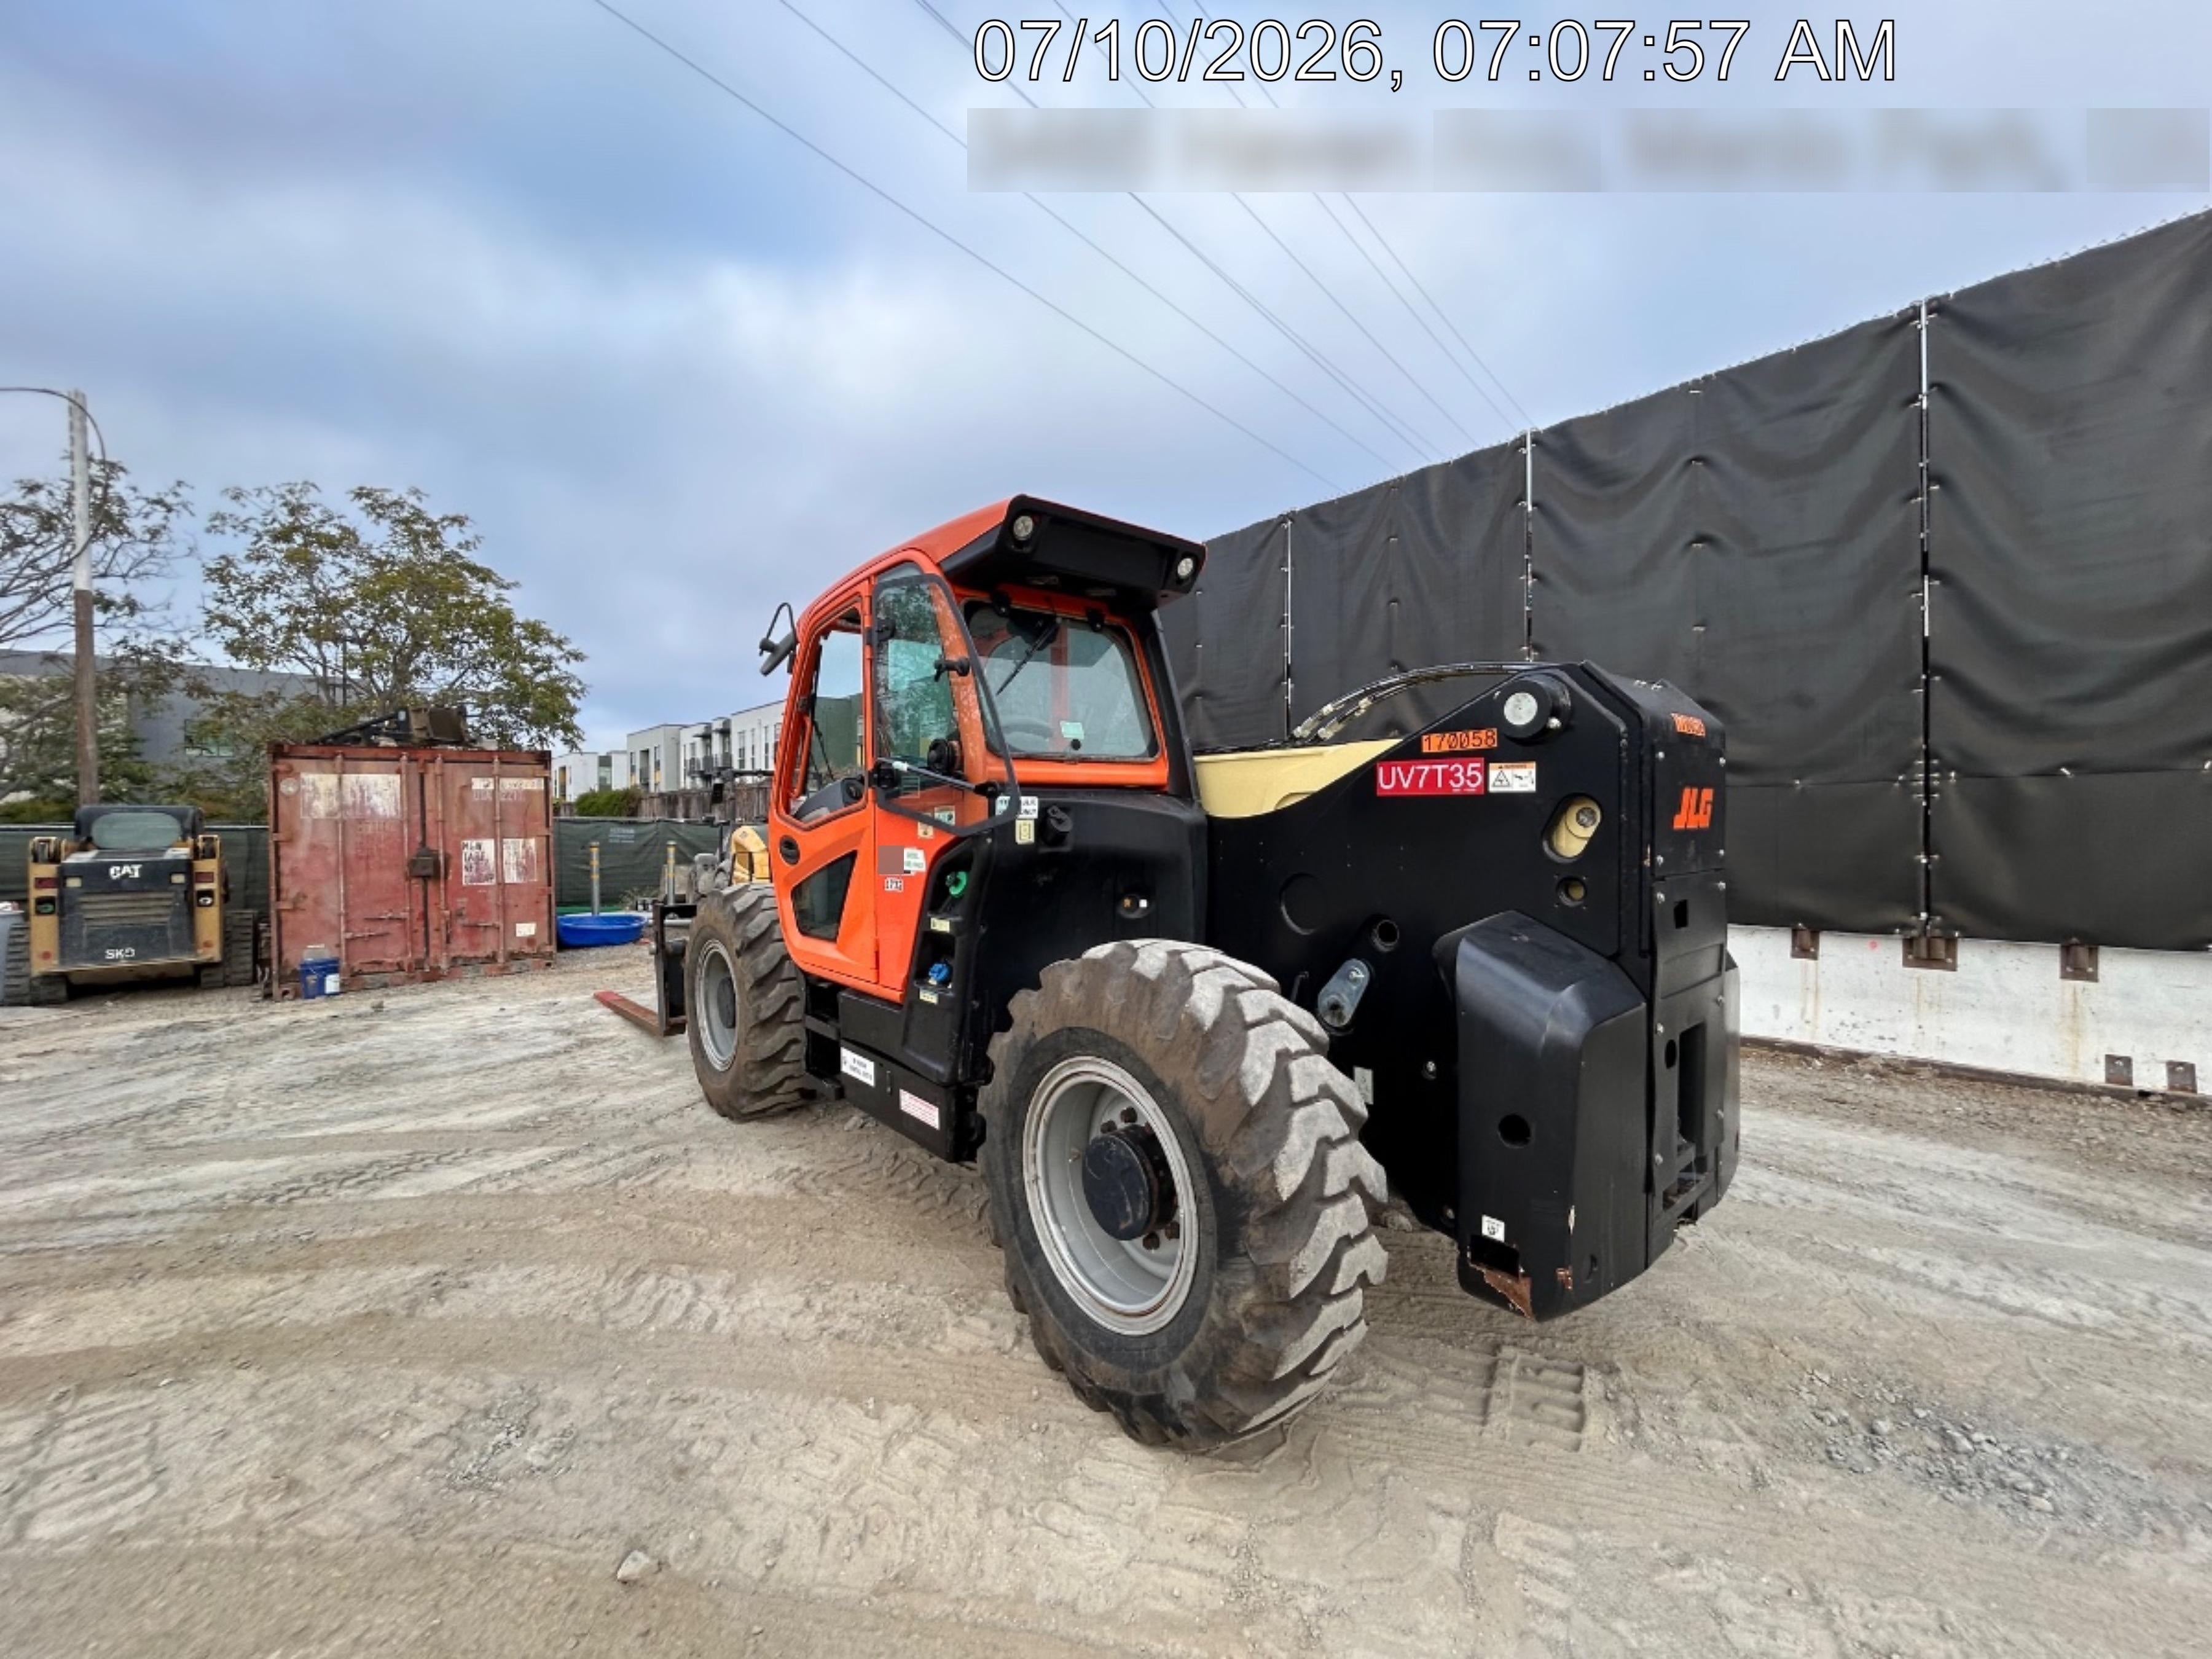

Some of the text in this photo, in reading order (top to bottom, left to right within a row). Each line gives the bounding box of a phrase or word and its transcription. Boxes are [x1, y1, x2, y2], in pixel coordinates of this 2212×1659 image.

[1424, 729, 1496, 751] 170058
[1378, 763, 1483, 790] UV7T35
[1673, 787, 1714, 830] JLG
[109, 864, 143, 879] CAT
